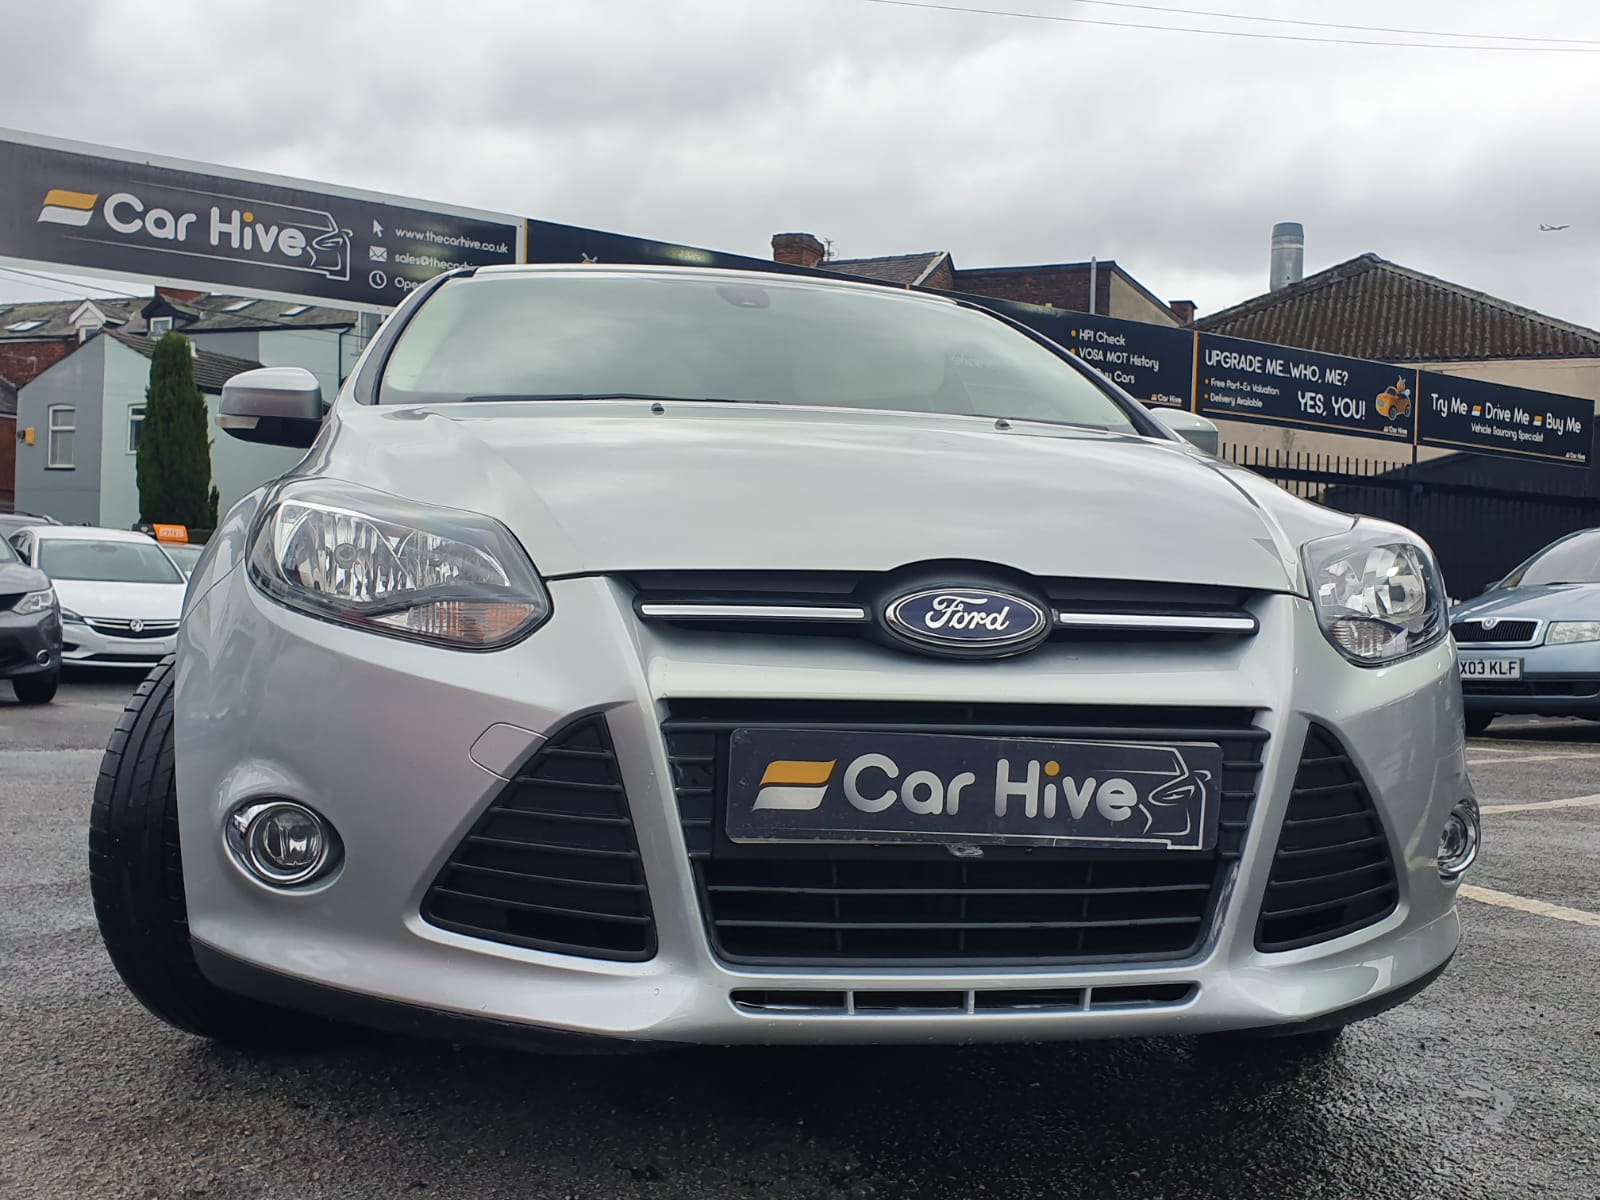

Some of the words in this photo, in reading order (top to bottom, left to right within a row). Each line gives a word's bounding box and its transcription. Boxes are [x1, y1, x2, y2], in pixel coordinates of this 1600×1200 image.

[103, 193, 197, 241] Car
[210, 206, 306, 257] Hive
[395, 228, 509, 254] www.thecarhive.co.uk
[395, 253, 476, 270] sales@thecarh
[394, 277, 423, 292] Ope
[1079, 329, 1094, 341] HPI
[1096, 331, 1126, 346] Check
[1079, 347, 1104, 361] VOSA
[1106, 350, 1128, 364] MOT
[1130, 354, 1159, 372] History
[1205, 349, 1263, 373] UPGRADE
[1325, 368, 1348, 386] ME?
[1114, 371, 1135, 384] Cars
[1210, 377, 1226, 388] Free
[1252, 383, 1279, 395] Valuation
[1210, 393, 1236, 407] Delivery
[1298, 390, 1327, 416] YES,
[1332, 396, 1366, 420] YOU!
[1431, 393, 1448, 417] Try
[1450, 397, 1468, 415] Me
[1485, 402, 1511, 422] Drive
[1513, 407, 1530, 425] Me
[1546, 413, 1564, 435] Buy
[1566, 417, 1581, 433] Me
[1471, 423, 1491, 435] Vehicle
[1493, 425, 1518, 442] Sourcing
[1518, 430, 1544, 442] Specialist
[926, 595, 1011, 631] Ford
[1460, 661, 1485, 675] X03
[1490, 661, 1517, 675] KLF
[843, 753, 976, 816] Car
[994, 759, 1138, 822] Hive
